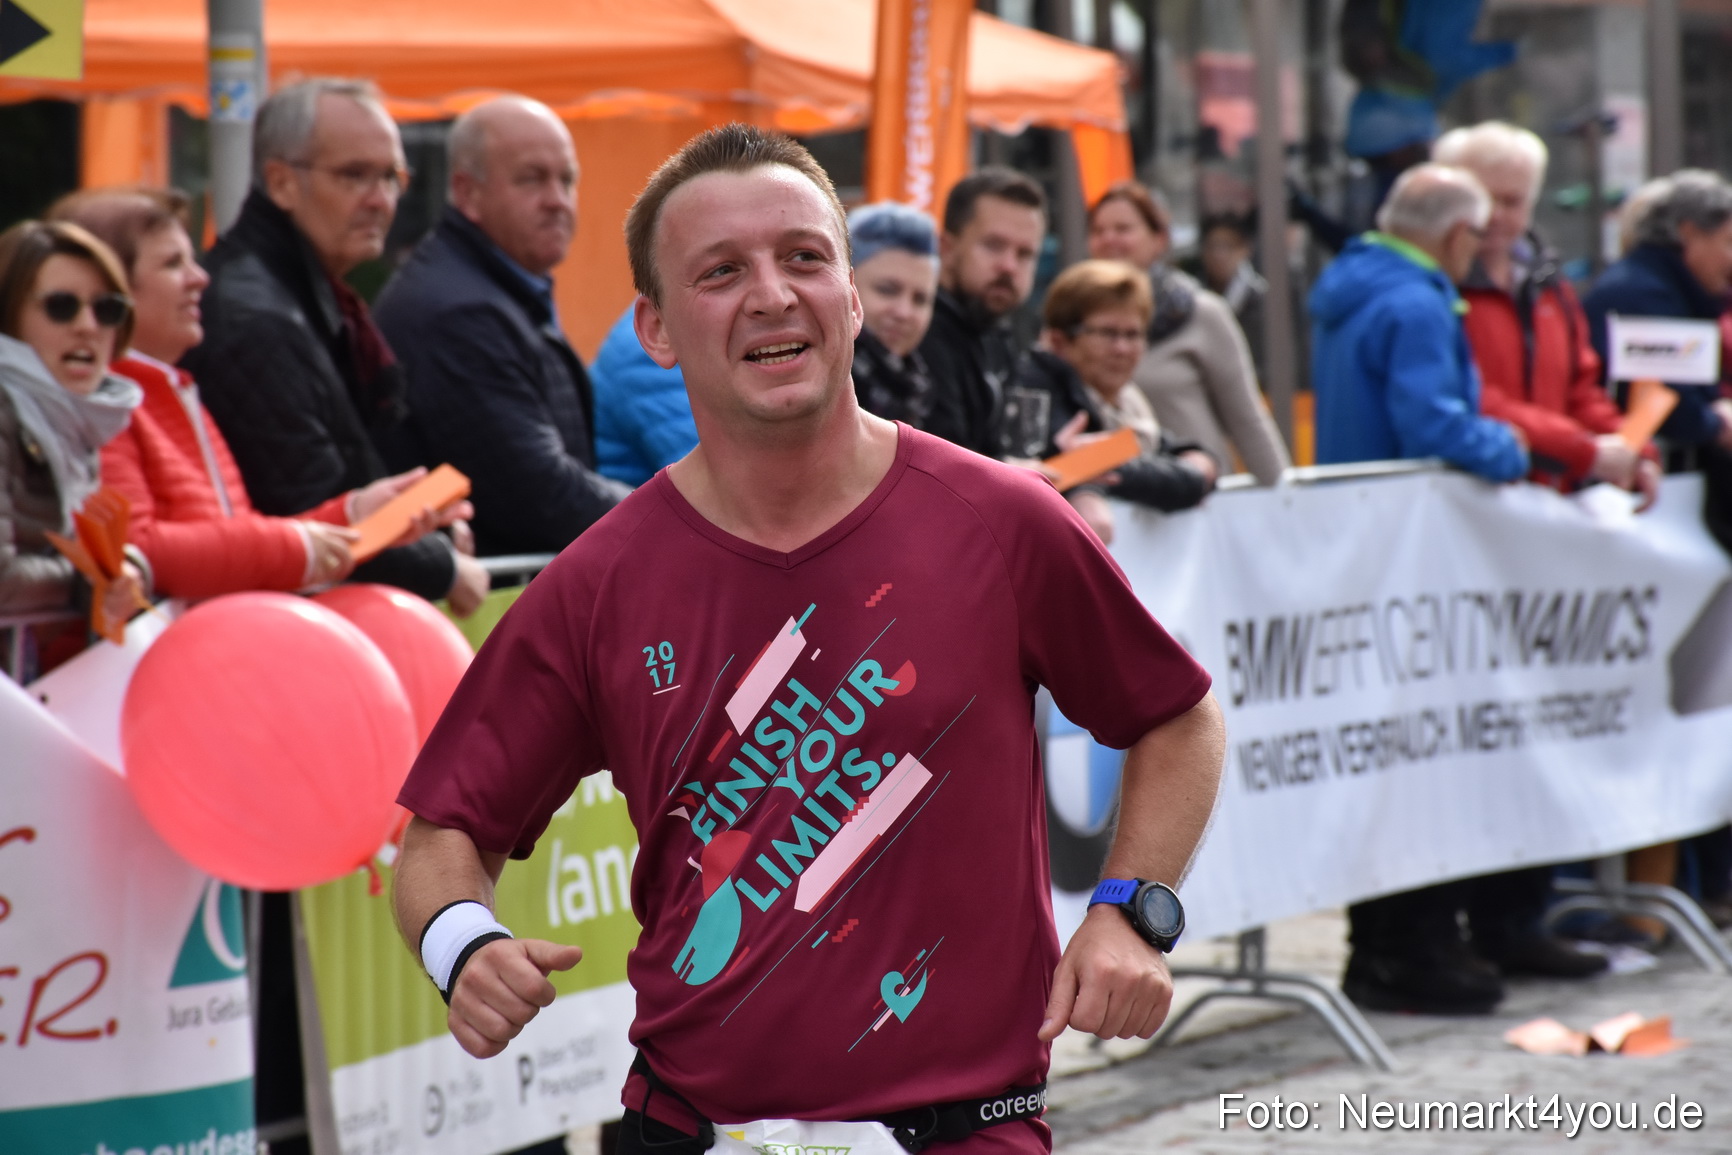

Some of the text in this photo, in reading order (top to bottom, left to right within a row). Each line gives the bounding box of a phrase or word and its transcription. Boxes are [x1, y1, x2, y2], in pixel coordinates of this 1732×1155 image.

[642, 641, 674, 667] 20
[649, 662, 676, 688] 17
[1223, 614, 1314, 706] BMW
[689, 677, 822, 847] FINISH
[773, 659, 900, 799] YOUR
[734, 747, 897, 913] LIMITS.
[547, 838, 640, 929] lan
